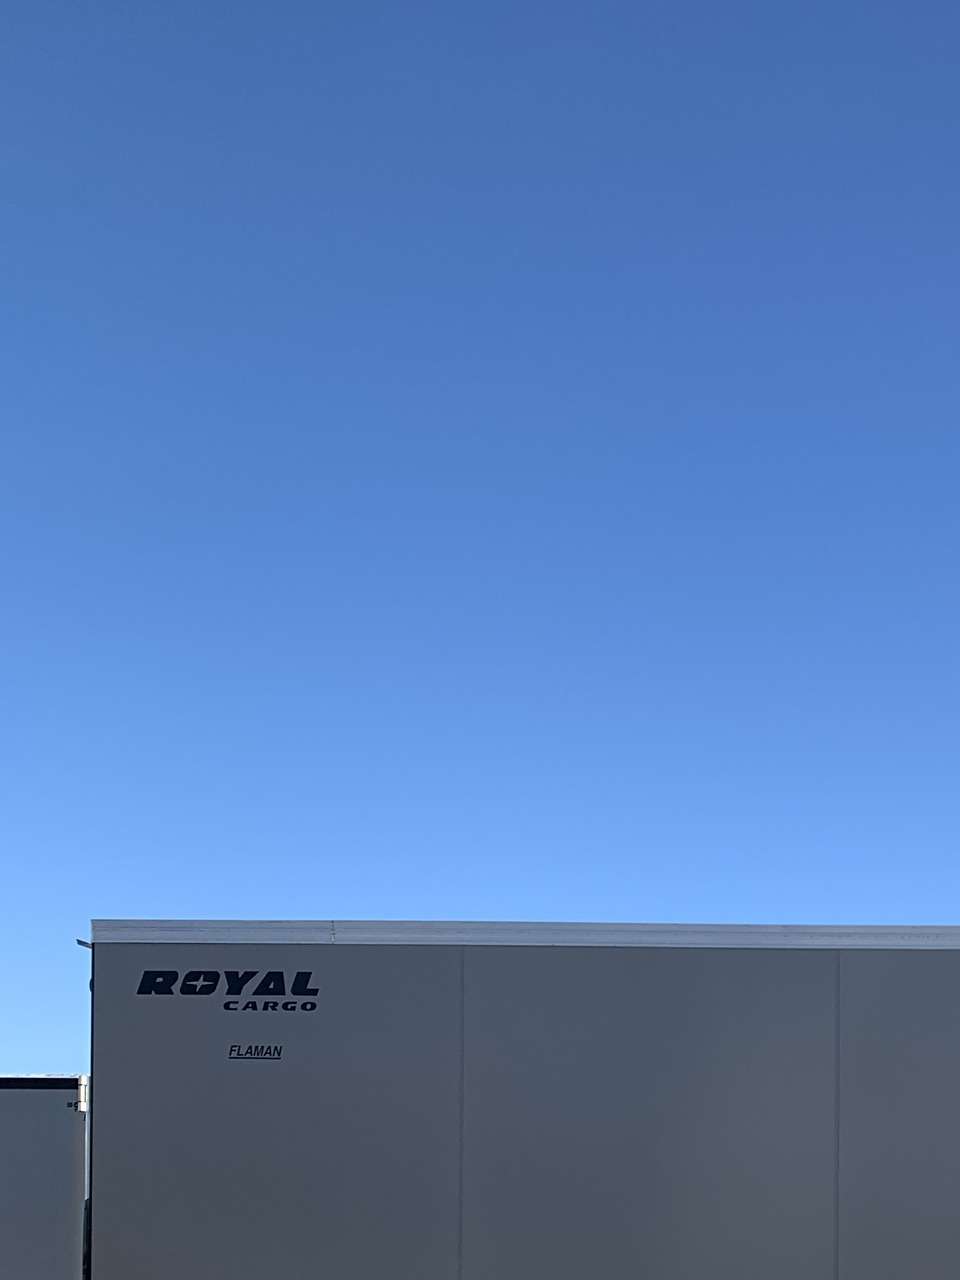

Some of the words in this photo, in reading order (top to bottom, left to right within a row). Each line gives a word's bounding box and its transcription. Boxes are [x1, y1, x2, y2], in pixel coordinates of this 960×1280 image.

[136, 970, 320, 996] ROYAL
[223, 1001, 317, 1012] CARGO
[228, 1045, 282, 1058] FLAMAN
